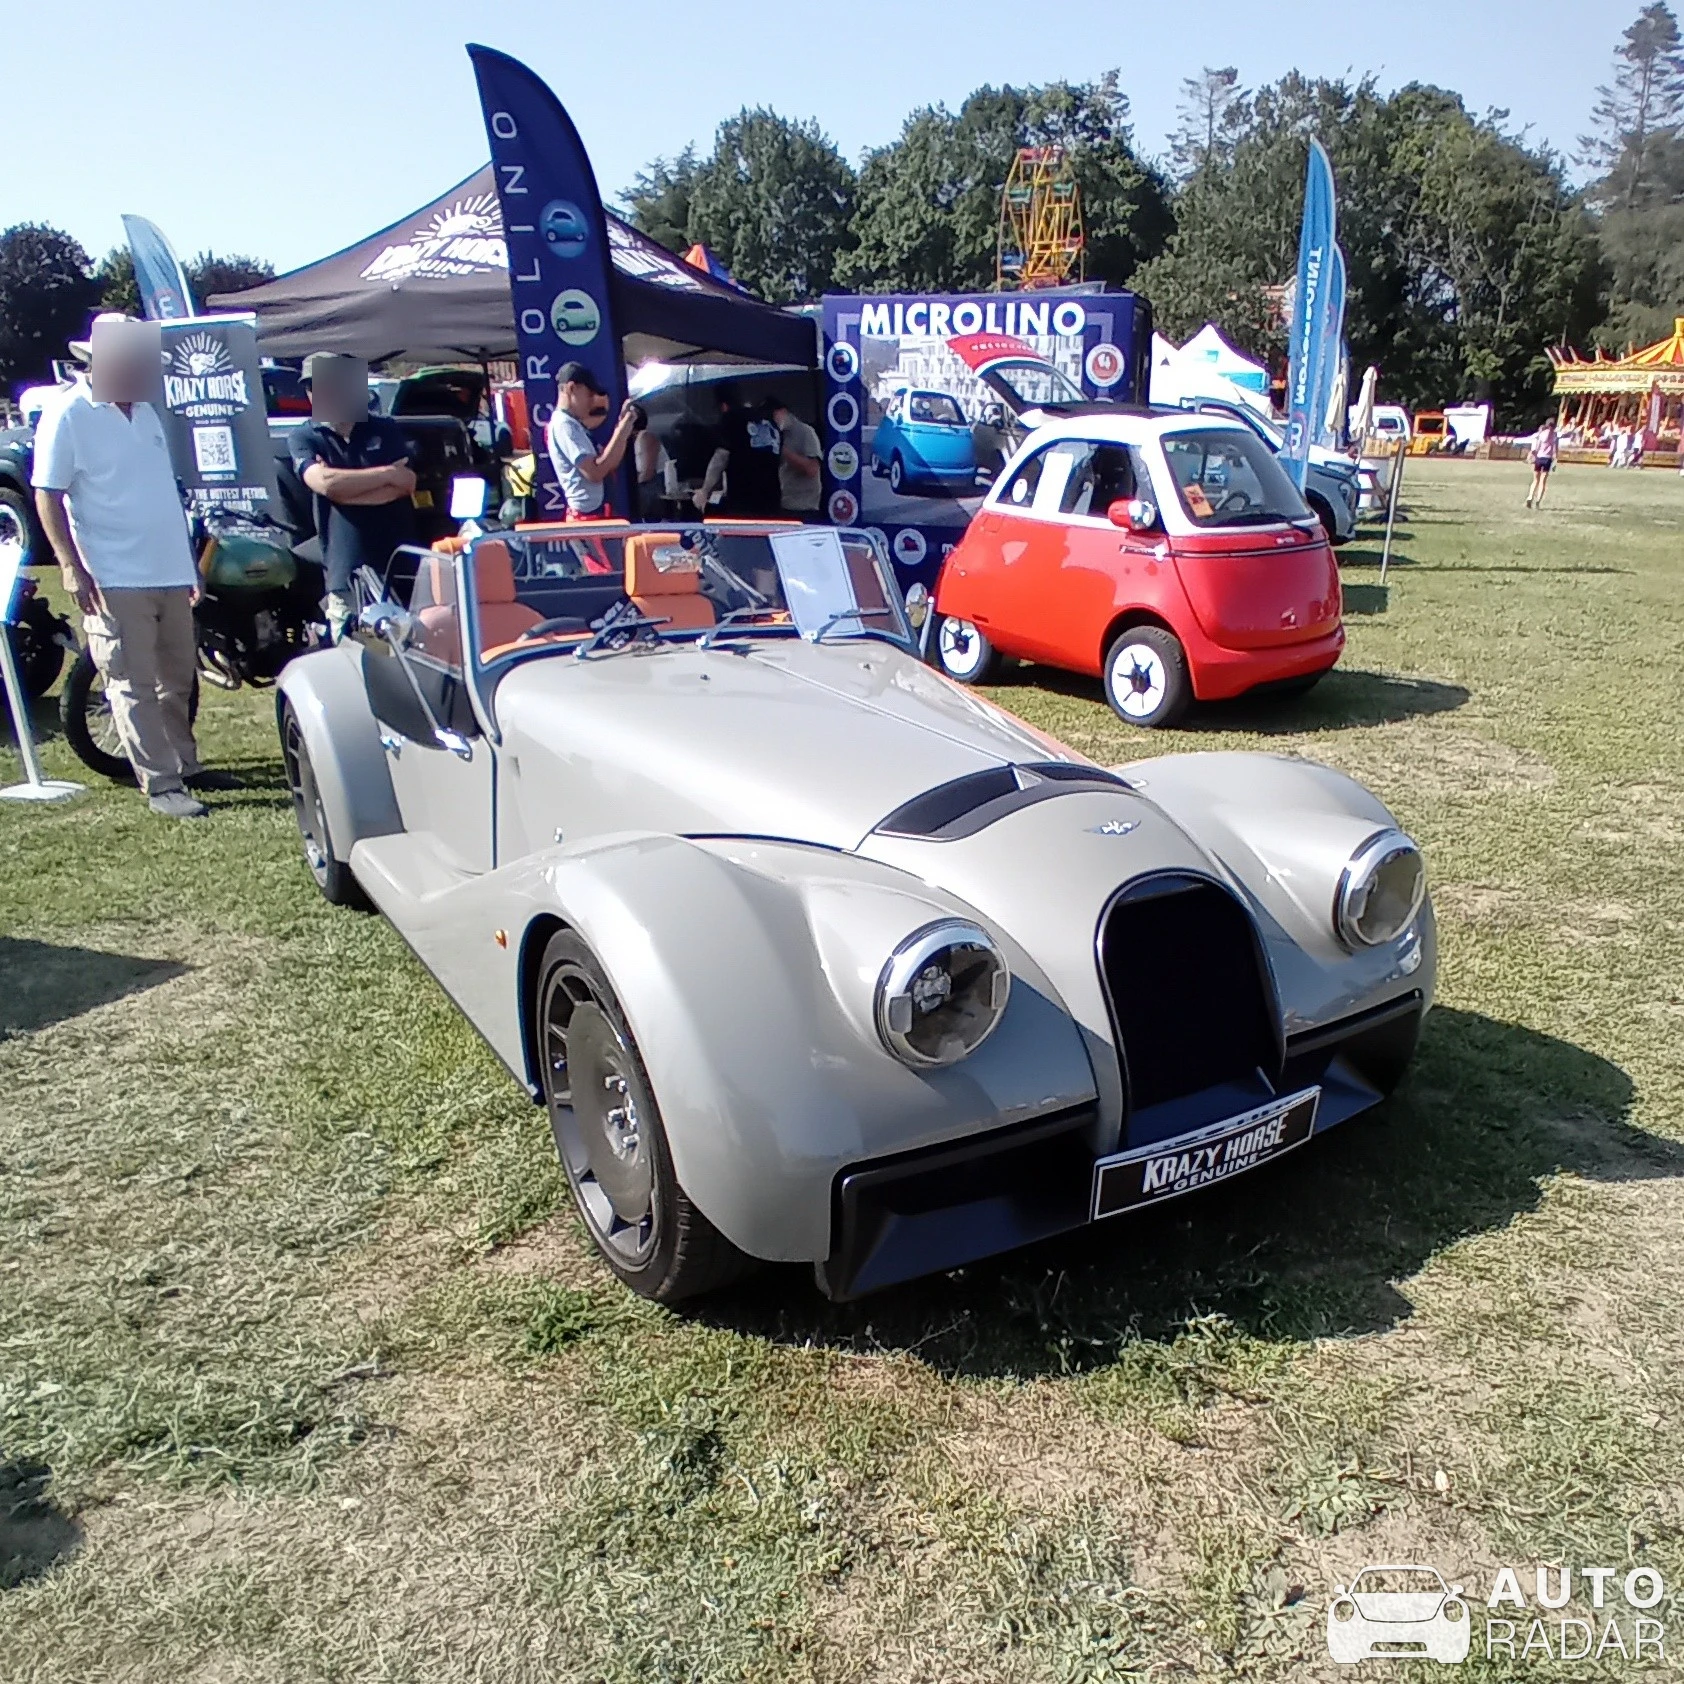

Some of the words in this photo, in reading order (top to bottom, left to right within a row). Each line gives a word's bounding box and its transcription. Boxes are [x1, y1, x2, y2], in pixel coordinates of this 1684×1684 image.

[860, 302, 1086, 336] MICROLINO
[163, 374, 206, 409] KRAZY
[206, 370, 249, 405] HORSE
[185, 403, 235, 418] GENUINE
[1142, 1143, 1223, 1194] KRAZY
[1224, 1112, 1289, 1162] HORSE
[1173, 1152, 1259, 1191] GENUINE
